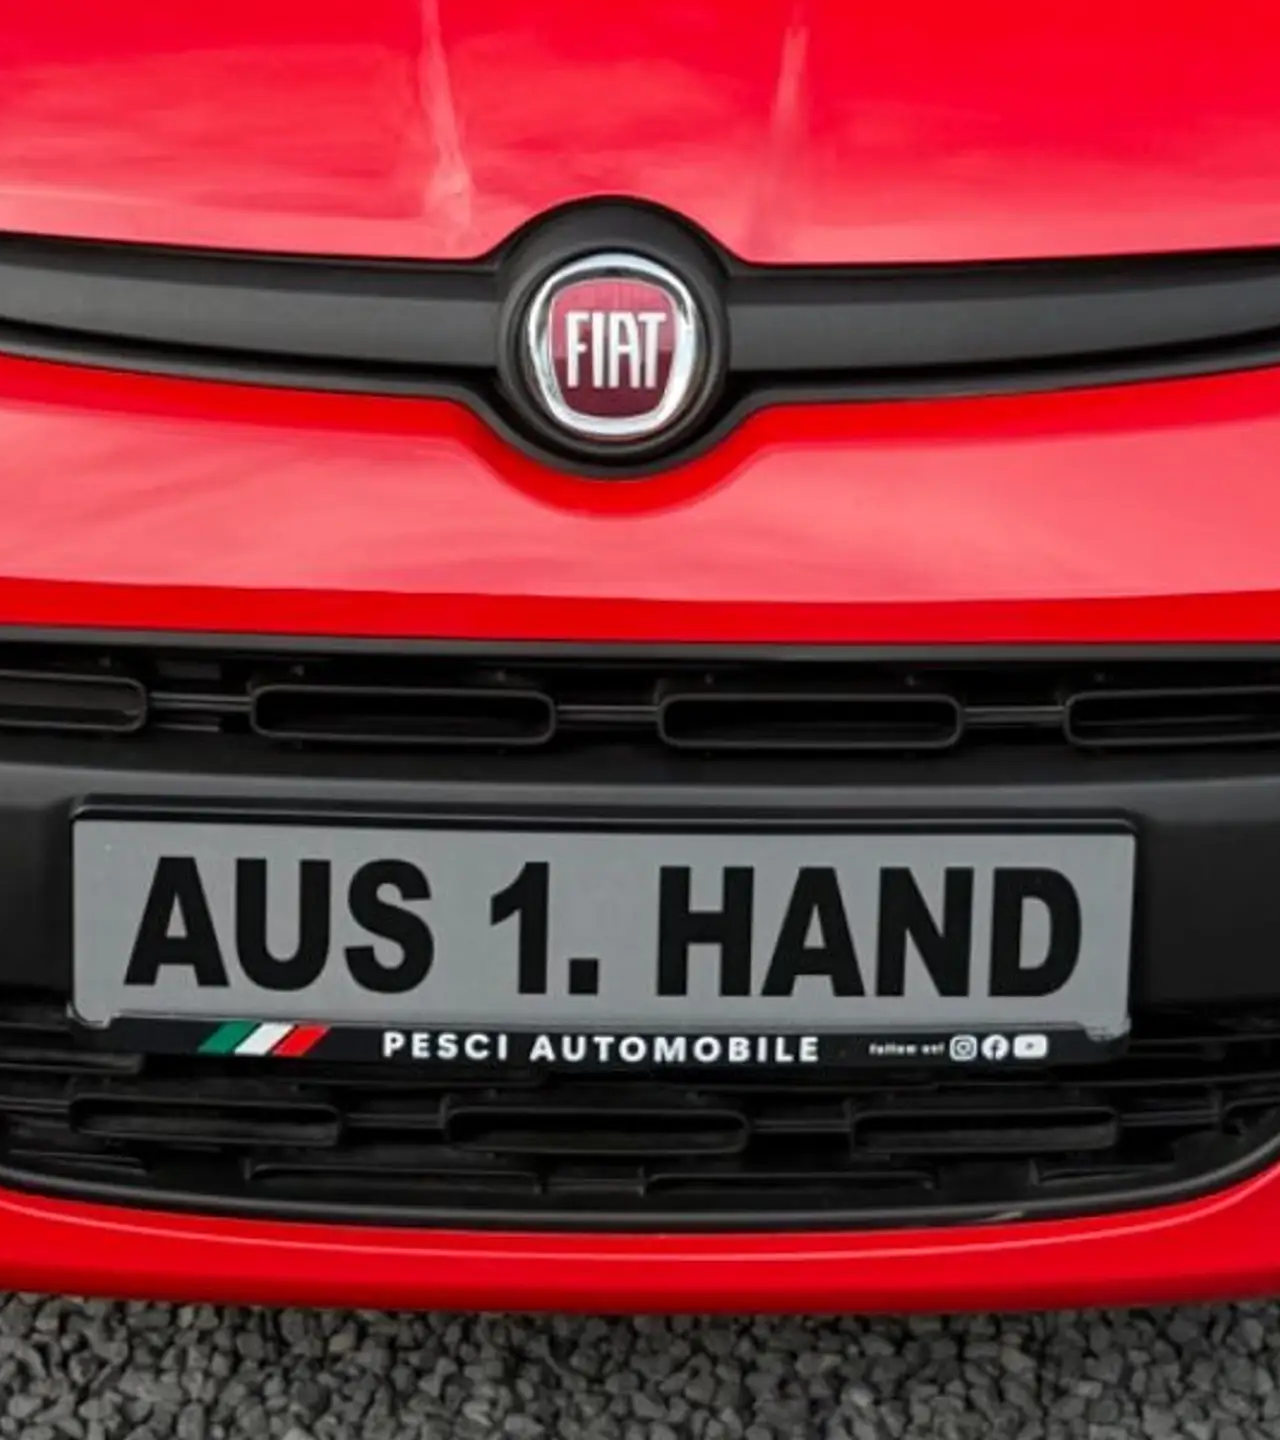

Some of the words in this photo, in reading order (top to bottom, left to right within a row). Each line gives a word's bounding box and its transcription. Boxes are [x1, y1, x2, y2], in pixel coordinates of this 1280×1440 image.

[565, 311, 667, 389] FIAT
[123, 856, 434, 994] AUS
[490, 861, 599, 996] 1.
[656, 865, 1082, 999] HAND
[383, 1031, 508, 1060] PESCI
[529, 1034, 819, 1064] AUTOMOBILE
